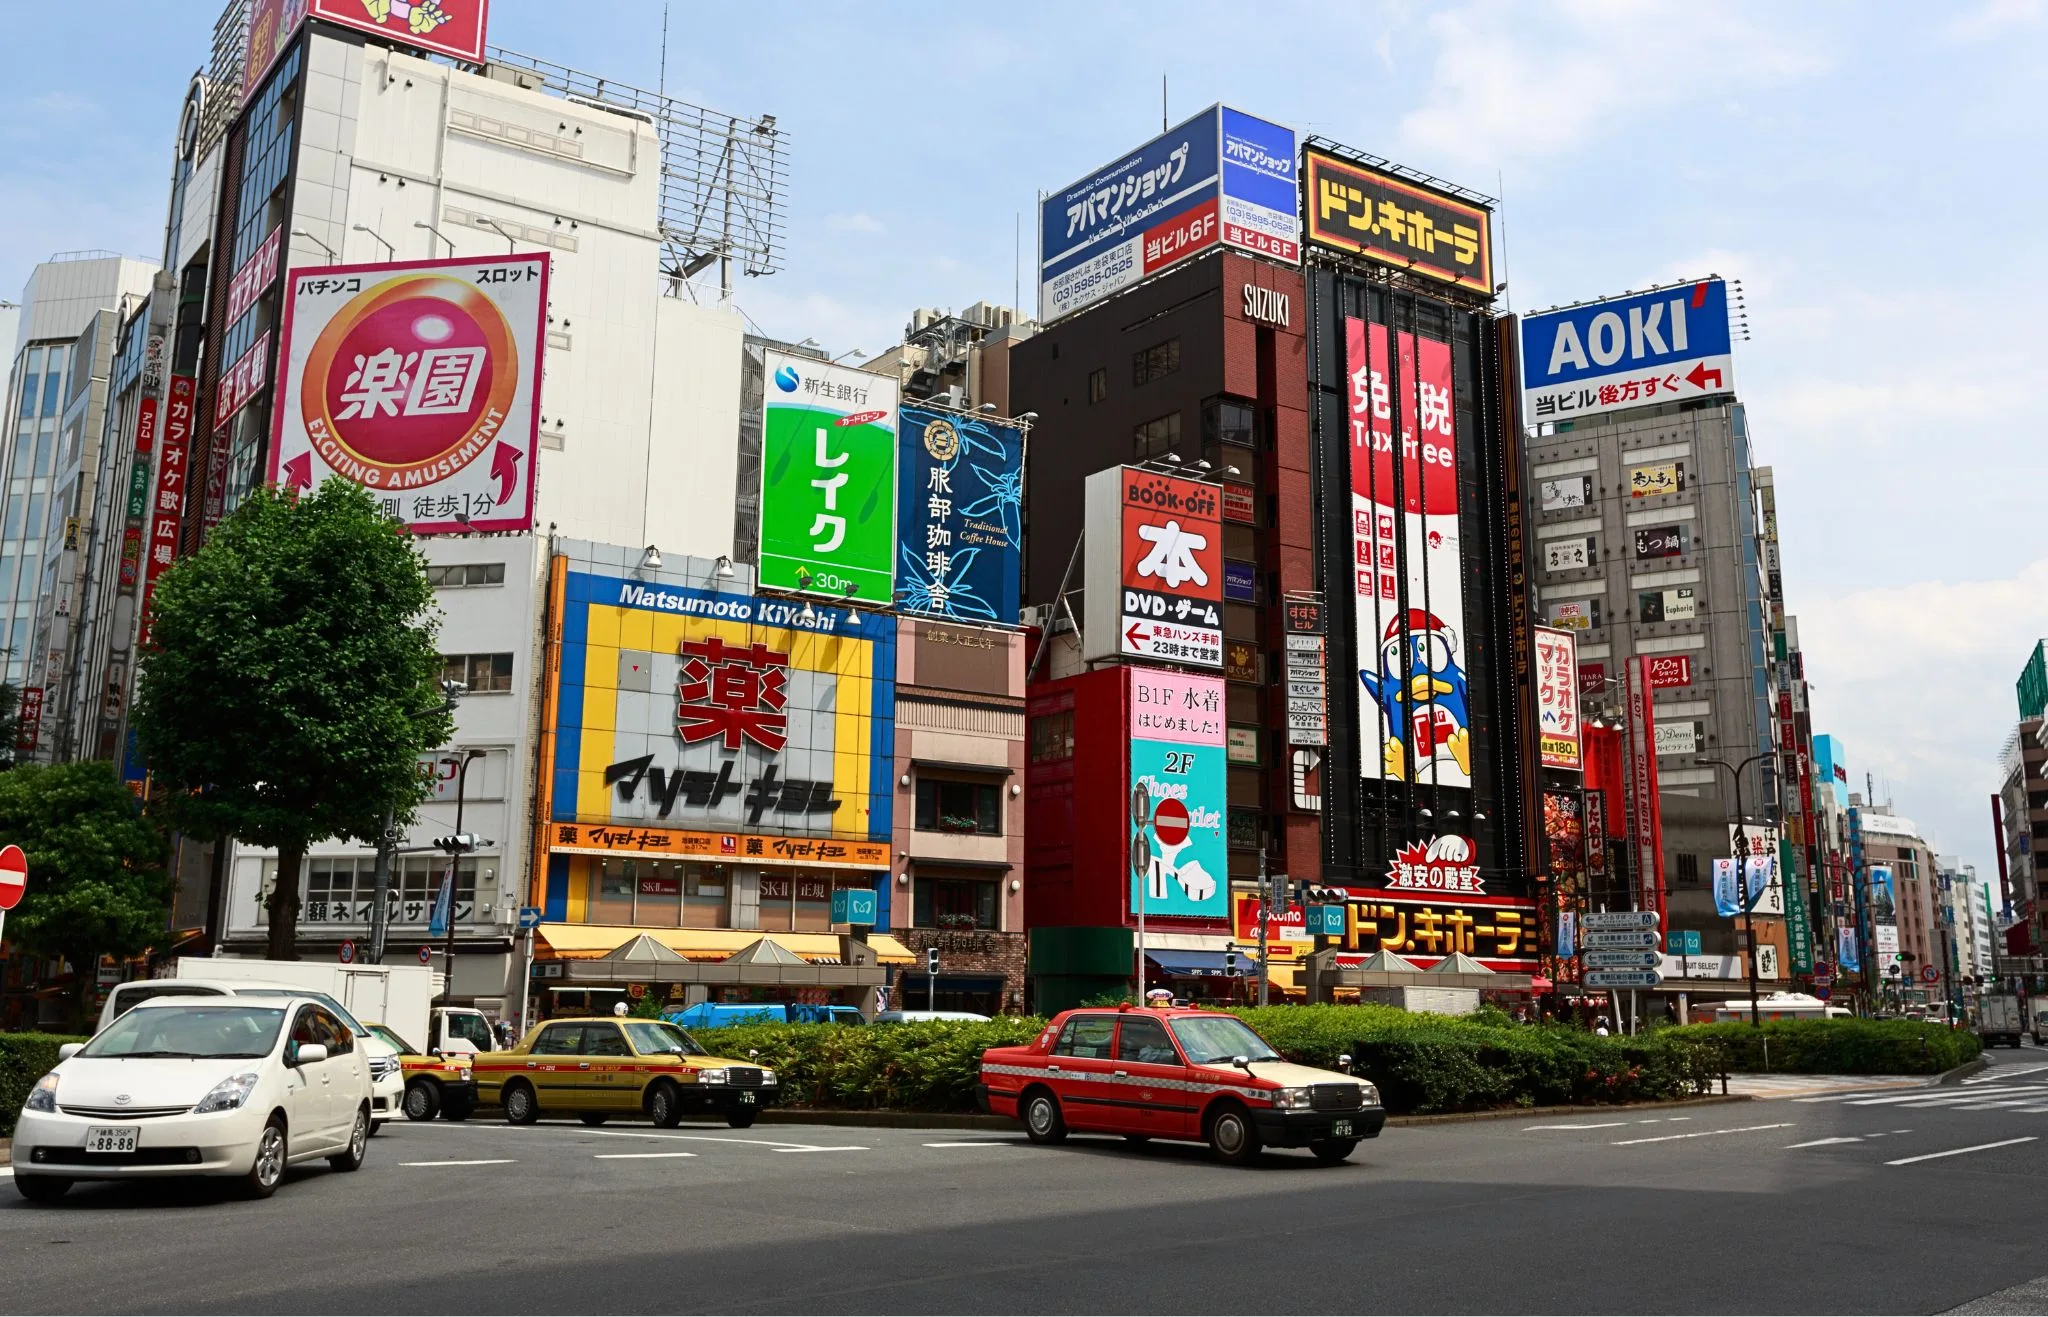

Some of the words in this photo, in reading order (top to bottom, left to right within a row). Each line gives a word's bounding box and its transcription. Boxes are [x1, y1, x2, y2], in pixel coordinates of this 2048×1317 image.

[1226, 140, 1291, 173] アパマンショップ
[1066, 141, 1189, 238] アパマンショップ
[1226, 205, 1294, 234] (03)5985-0525
[1146, 212, 1215, 263] 当ビル6F
[1230, 226, 1291, 256] 当ビル6F
[298, 278, 361, 295] パチンコ
[476, 266, 538, 284] スロット
[1052, 256, 1133, 305] (03)5985-0525
[1244, 283, 1289, 326] SUZUKI
[1547, 298, 1688, 375] AOKI
[334, 346, 486, 421] 楽園
[804, 376, 868, 405] 新生銀行
[141, 412, 152, 438] アコム
[842, 411, 880, 426] カードローン
[308, 417, 380, 486] EXCITING
[387, 407, 505, 488] AMUSEMENT
[809, 427, 849, 552] レイク
[926, 466, 953, 610] 服部珈琲舎
[960, 531, 985, 545] Coffee
[987, 534, 1009, 548] House
[963, 518, 1008, 535] Traditional
[1637, 536, 1679, 553] もつ鍋
[619, 584, 751, 619] Matsumoto
[1665, 604, 1693, 615] Euphoria
[1153, 625, 1219, 646] 東急ハンズ手前
[1152, 641, 1219, 662] 23時まで営業
[1538, 643, 1555, 705] マック
[1556, 643, 1574, 733] カラオケ
[677, 636, 789, 752] 薬
[1182, 686, 1219, 713] 水着
[1633, 693, 1642, 719] SLOT
[1164, 751, 1194, 775] 2F
[604, 754, 843, 824] マツモトキヨシ
[559, 826, 578, 844] 薬
[588, 828, 671, 850] マツモトキヨシ
[746, 838, 763, 855] 薬
[773, 840, 847, 860] マツモトキヨシ
[1398, 862, 1474, 891] 激安の殿堂
[97, 1138, 133, 1150] 88-88
